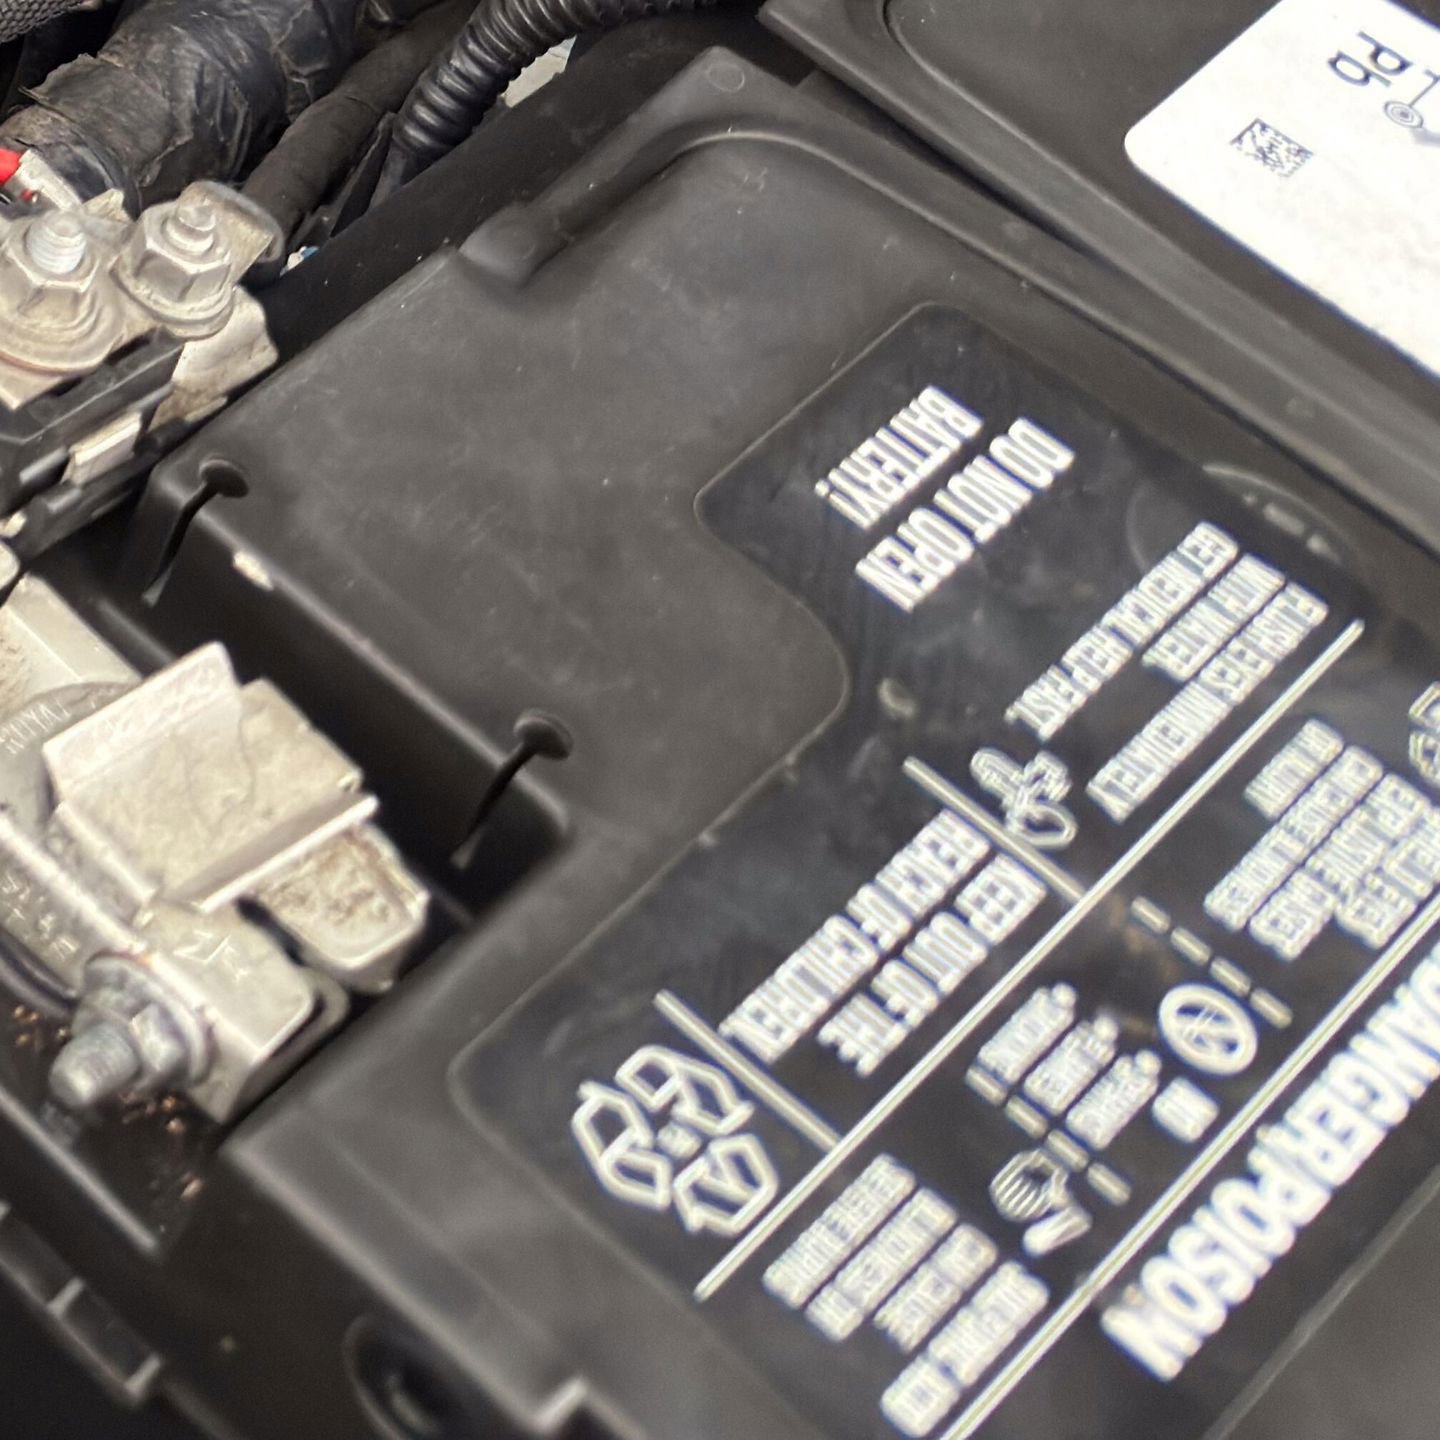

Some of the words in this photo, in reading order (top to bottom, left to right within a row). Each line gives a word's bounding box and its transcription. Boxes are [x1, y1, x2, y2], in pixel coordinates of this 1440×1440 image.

[815, 384, 983, 530] BATTERY!
[989, 417, 1075, 490] DO
[934, 454, 1034, 544] NOT
[855, 507, 976, 613] OPEN
[1173, 522, 1240, 581] GET
[1207, 552, 1286, 623] WITH
[1101, 552, 1208, 651] MEDICAL
[1240, 582, 1330, 662] FLUSH
[1053, 621, 1137, 697] HELP
[1195, 635, 1275, 708] EYES
[1083, 678, 1232, 825] IMMEDIATELY
[874, 809, 993, 917] REACH
[951, 854, 1048, 945] KEEP
[841, 880, 915, 953] OF
[900, 908, 989, 995] OUT
[715, 912, 883, 1065] CHILDREN.
[863, 955, 942, 1031] OF
[813, 991, 906, 1078] THE
